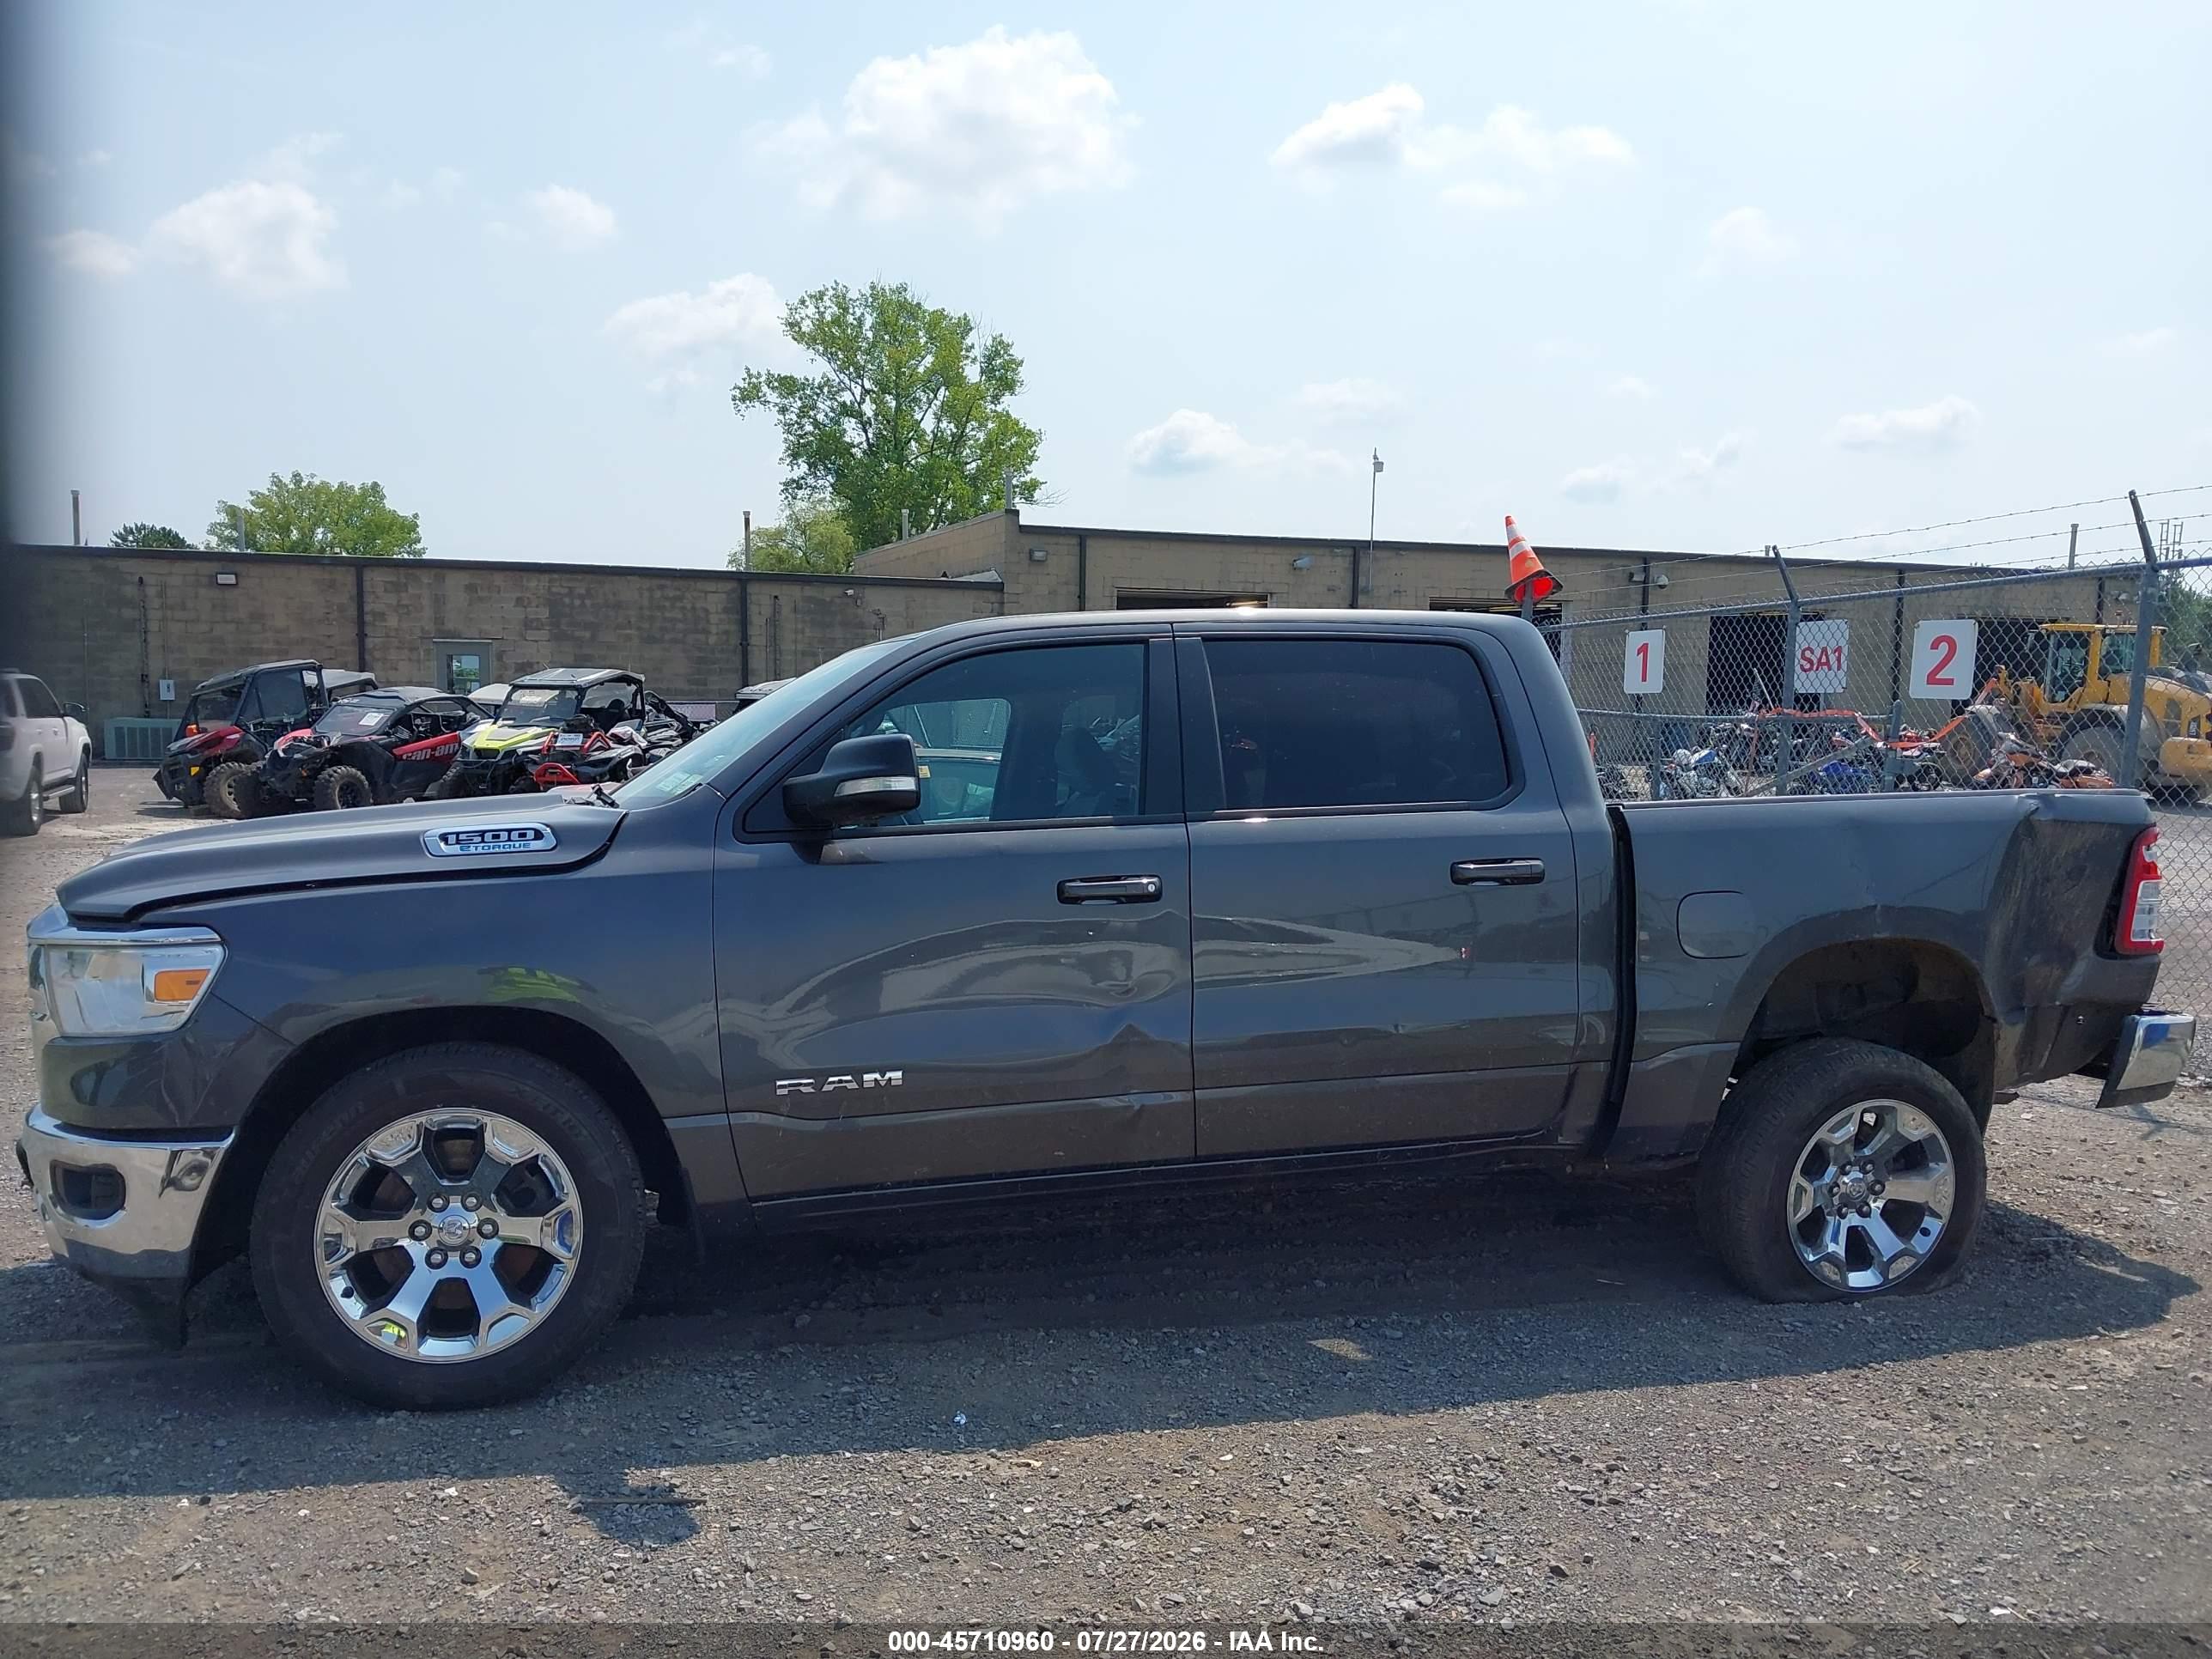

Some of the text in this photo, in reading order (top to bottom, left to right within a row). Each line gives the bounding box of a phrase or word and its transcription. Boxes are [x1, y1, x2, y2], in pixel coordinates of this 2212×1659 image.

[1636, 642, 1650, 683] 1
[1800, 646, 1842, 672] SA1
[1926, 635, 1959, 685] 2
[402, 743, 459, 760] can-am
[445, 830, 535, 845] 1500
[775, 1070, 903, 1096] RAM
